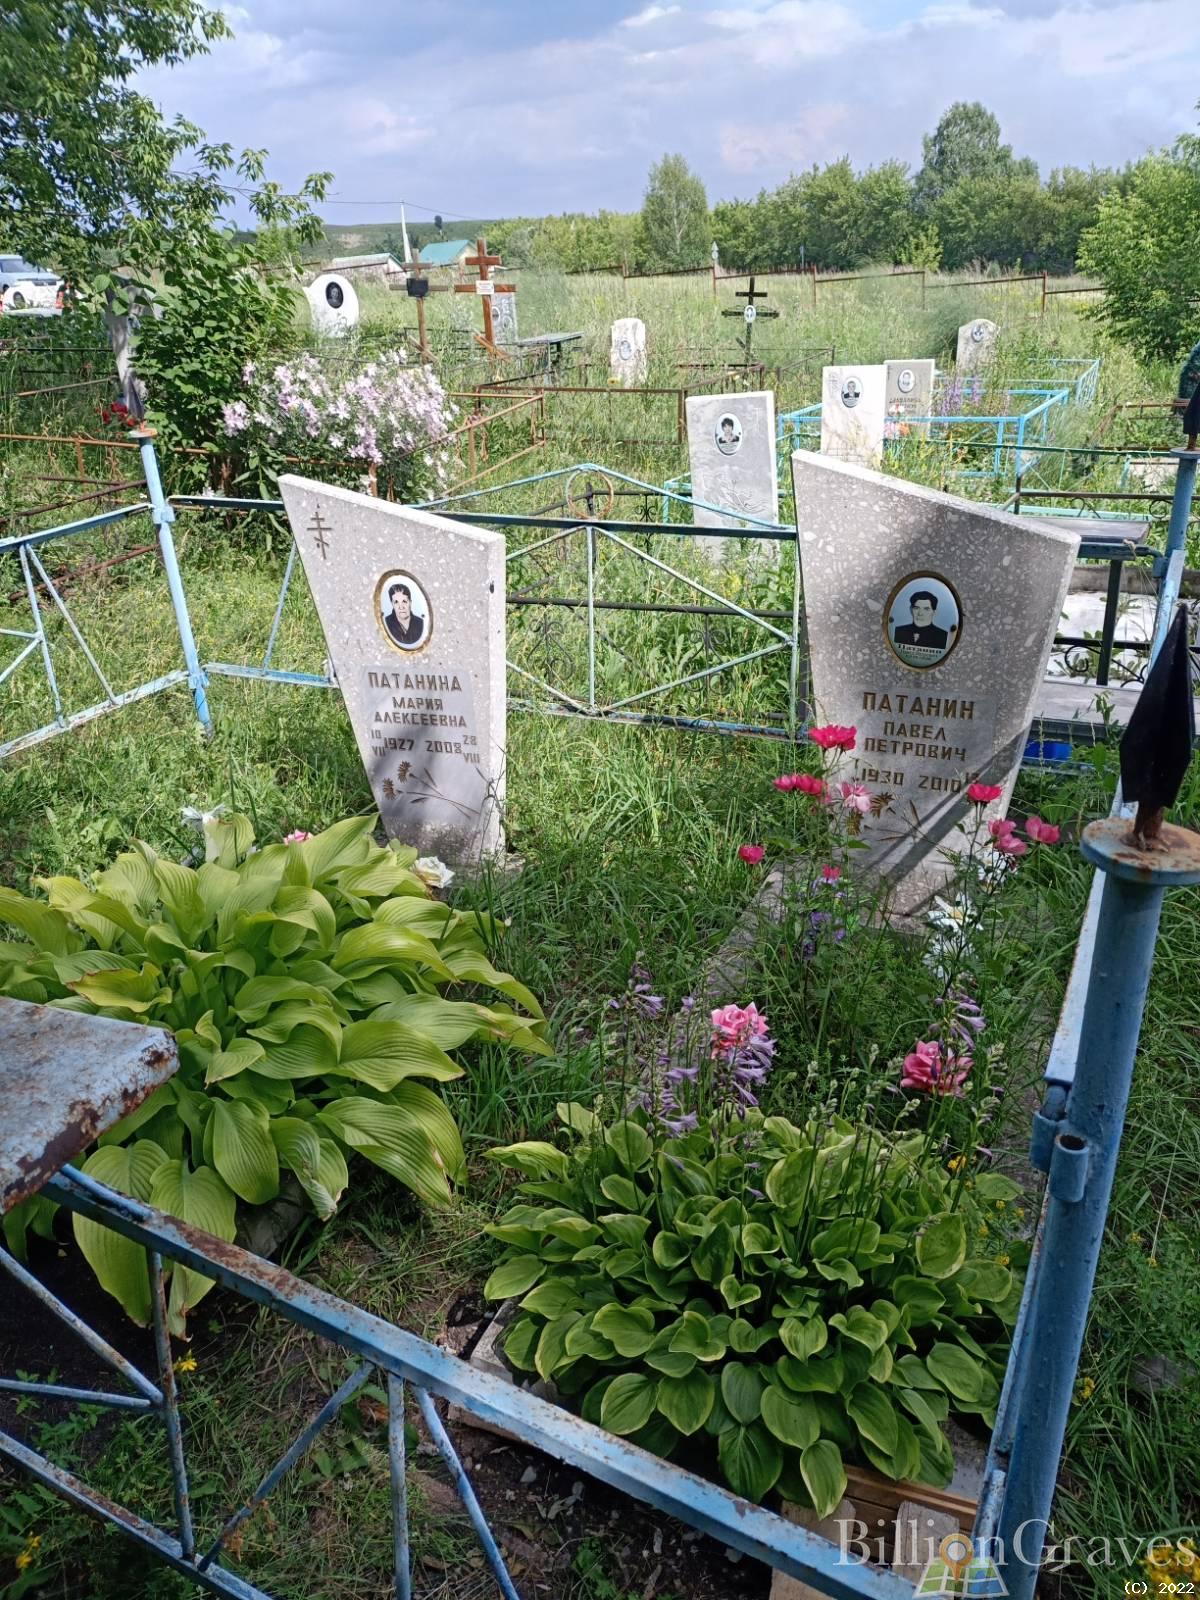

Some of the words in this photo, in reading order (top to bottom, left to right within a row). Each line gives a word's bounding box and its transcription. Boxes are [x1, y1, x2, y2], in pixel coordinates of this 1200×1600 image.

[367, 671, 463, 692] ПАТАНИНА
[391, 696, 444, 711] МАРИЯ
[862, 691, 975, 721] ПАТАНИН
[373, 711, 468, 728] АЛЕКСЕЕВНА
[370, 729, 382, 740] 10
[883, 721, 947, 742] ПАВЕЛ
[383, 737, 416, 752] 1927
[863, 737, 967, 762] ПЕТРОВИЧ
[861, 767, 905, 786] 1930
[918, 775, 962, 793] 2010
